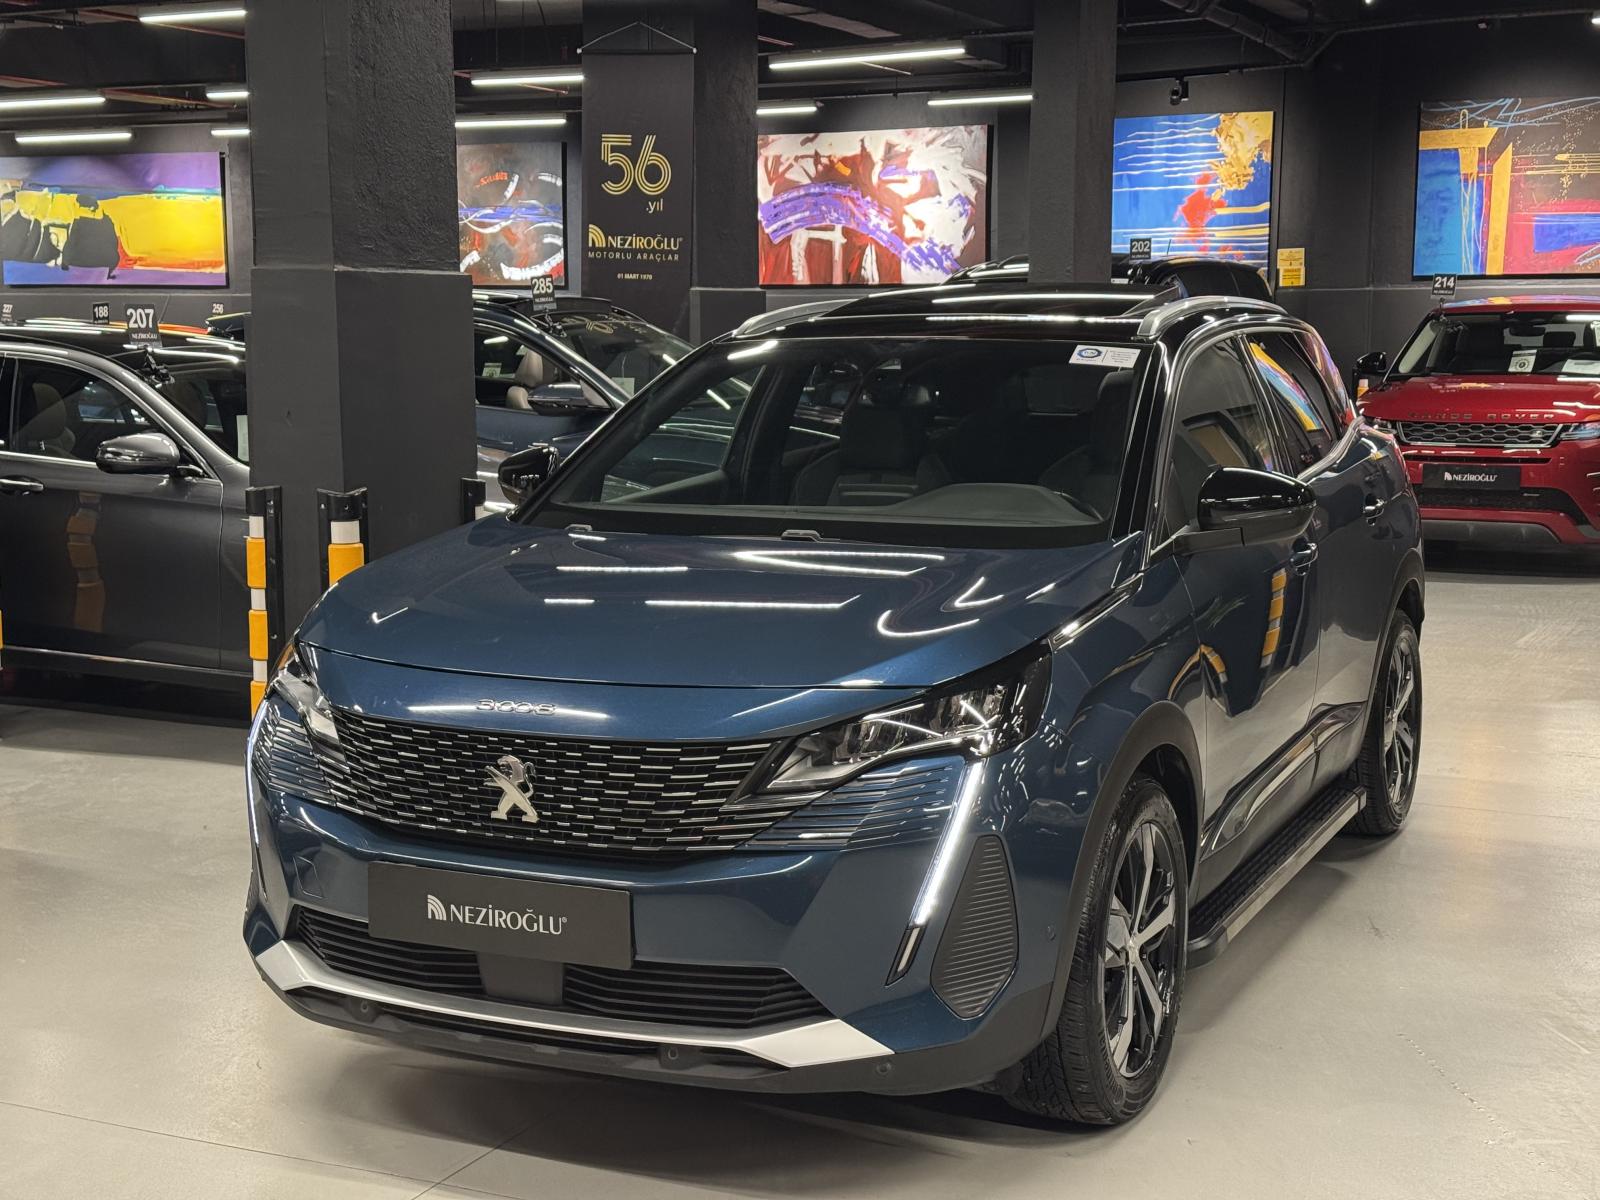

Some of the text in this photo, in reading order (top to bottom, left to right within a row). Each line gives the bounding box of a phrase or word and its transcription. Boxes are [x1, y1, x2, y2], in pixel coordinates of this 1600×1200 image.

[601, 133, 672, 195] 56
[1131, 240, 1150, 253] 202
[588, 251, 680, 263] MOTORLU ARAÇLAR
[531, 277, 554, 295] 285
[1434, 276, 1455, 289] 214
[93, 305, 109, 319] 188
[126, 308, 155, 329] 207
[476, 698, 557, 716] 3008
